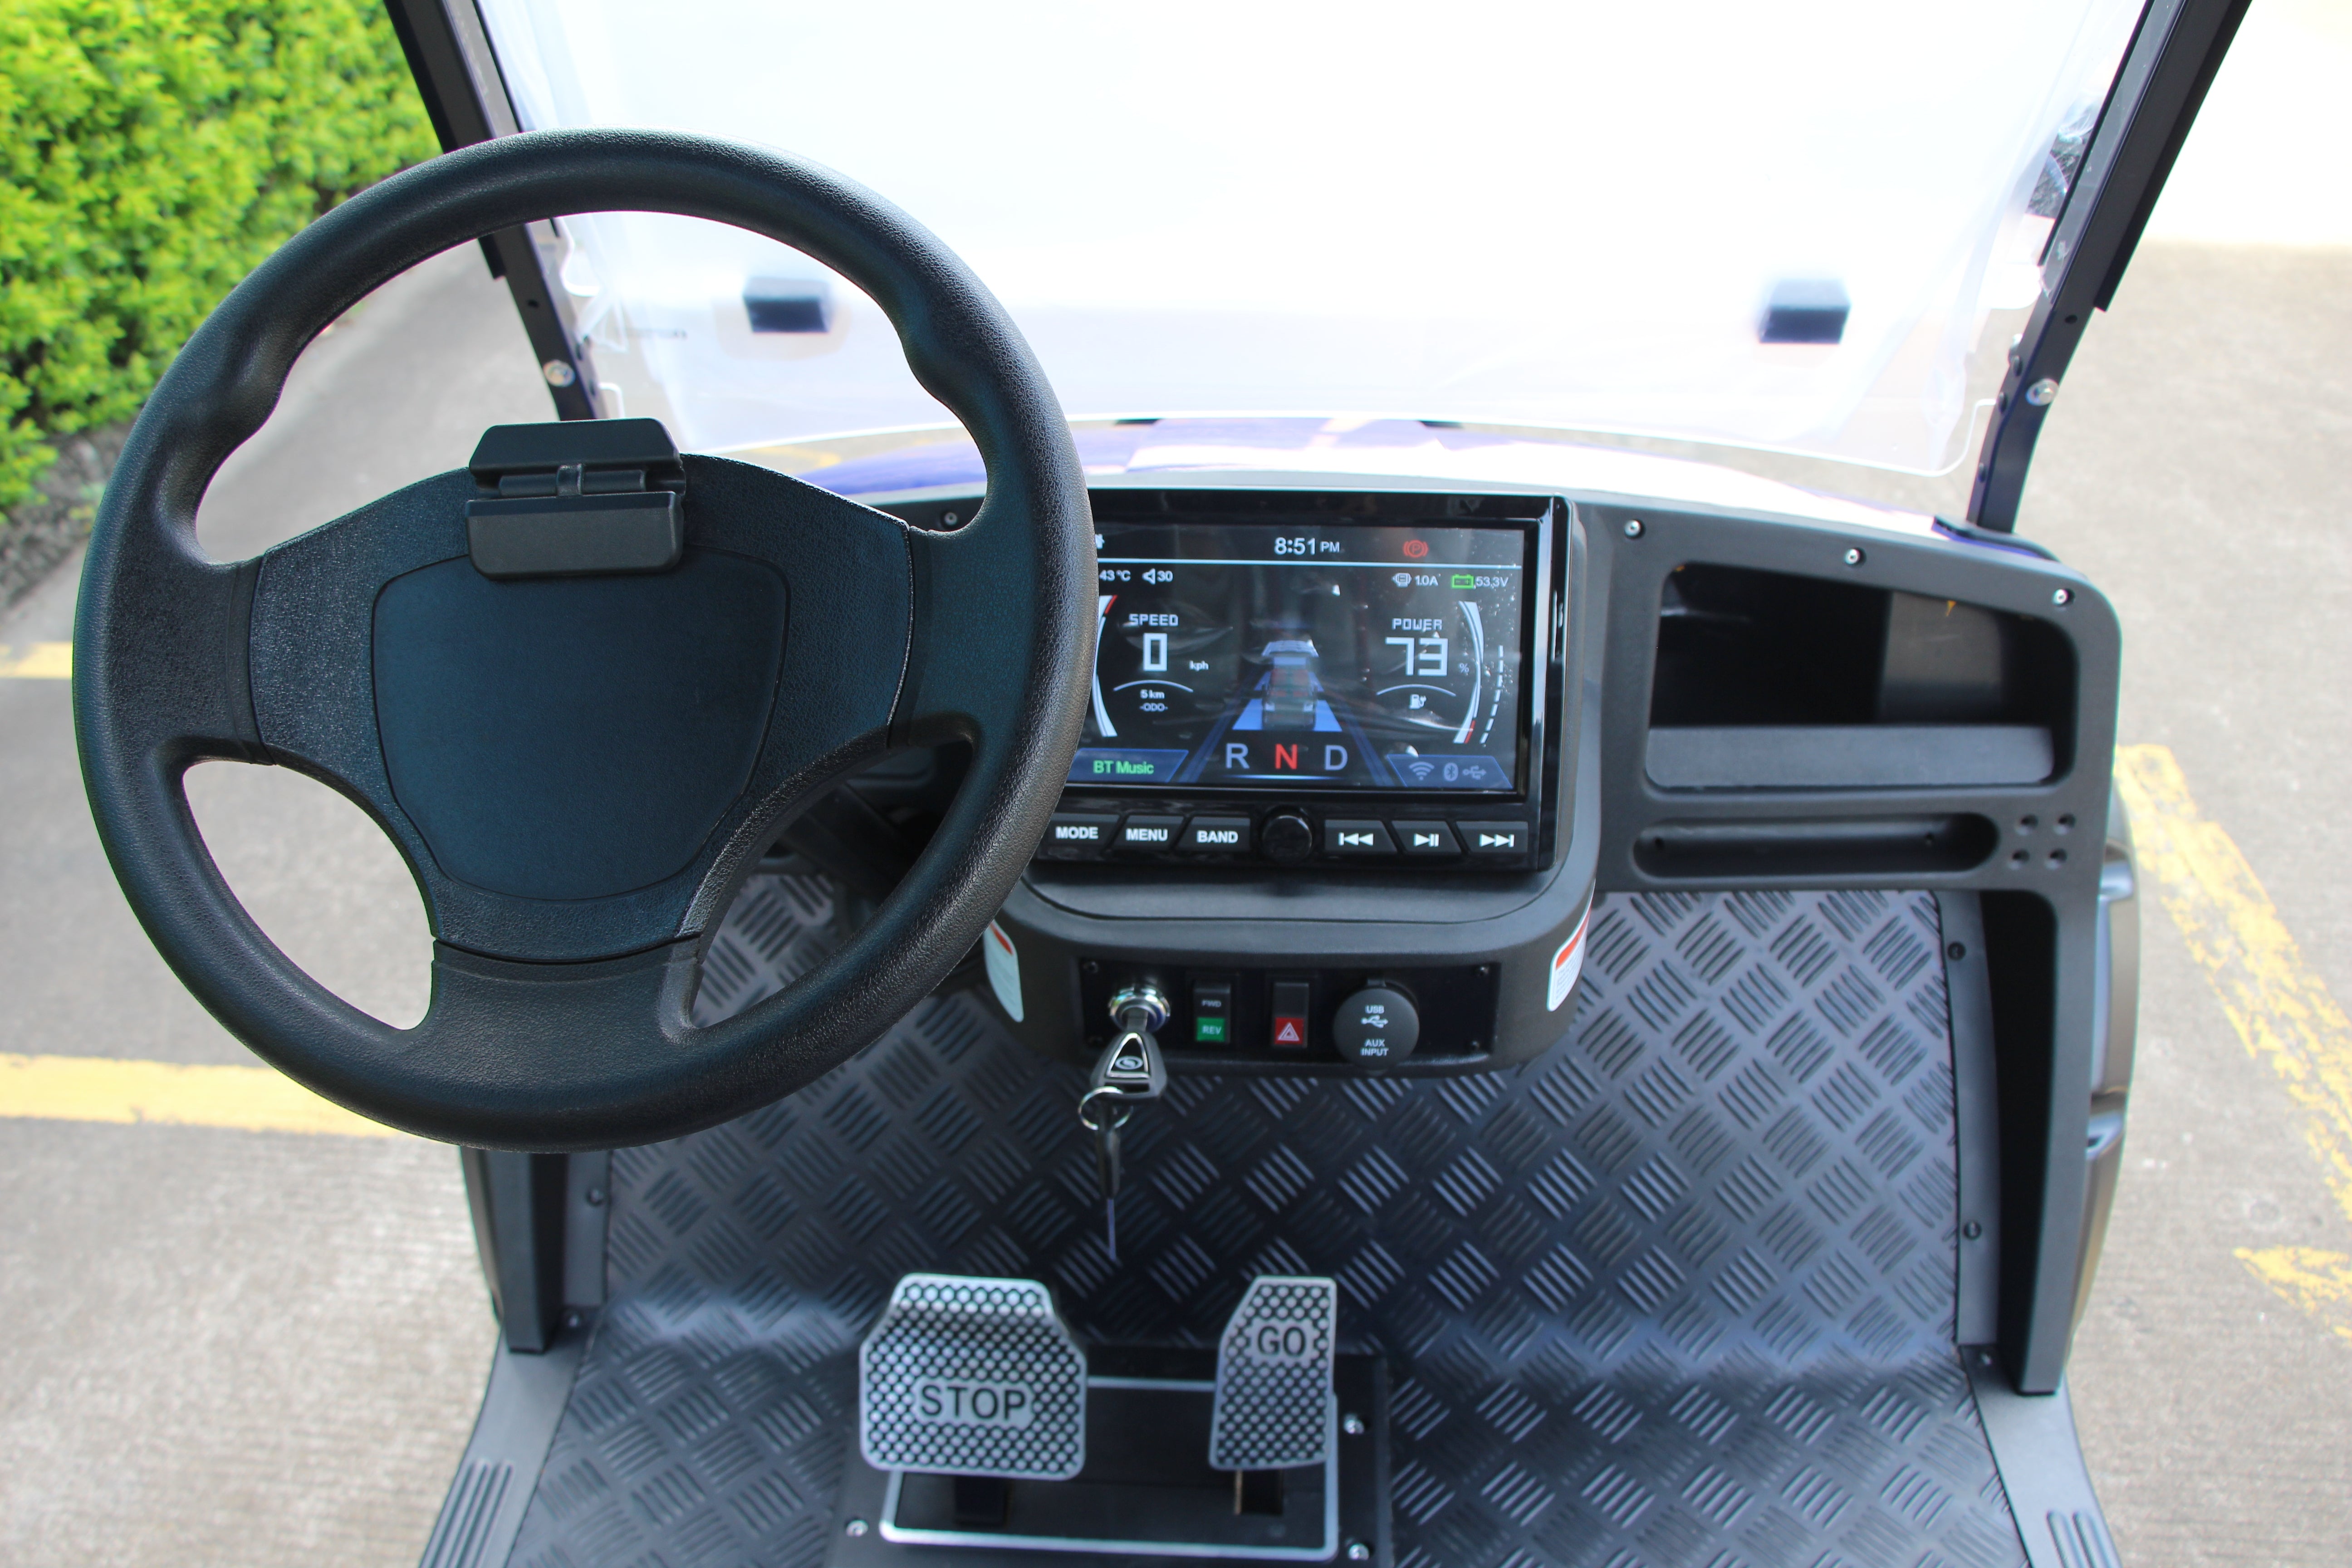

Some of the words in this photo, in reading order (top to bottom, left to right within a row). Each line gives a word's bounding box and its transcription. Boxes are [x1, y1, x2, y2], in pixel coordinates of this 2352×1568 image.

[1274, 537, 1315, 555] 8:51
[1320, 541, 1340, 553] PM
[1157, 570, 1173, 582] 30
[1475, 576, 1509, 588] 53.3V
[1128, 613, 1179, 627] SPEED
[1392, 618, 1442, 630] POWER
[1142, 633, 1168, 672] 0
[1189, 660, 1209, 671] kph
[1385, 637, 1449, 676] 73
[1225, 743, 1250, 769] R
[1275, 744, 1298, 769] N
[1324, 745, 1348, 771] D
[1093, 760, 1114, 774] BT
[1116, 760, 1154, 774] Music
[1055, 826, 1098, 839] MODE
[1126, 828, 1168, 842] MENU
[1196, 830, 1239, 843] BAND
[1365, 1005, 1385, 1014] USB
[1202, 1025, 1222, 1035] REV
[1364, 1039, 1385, 1048] AUX
[1360, 1046, 1389, 1056] INPUT
[1257, 1325, 1306, 1357] GO
[921, 1385, 1027, 1421] STOP
